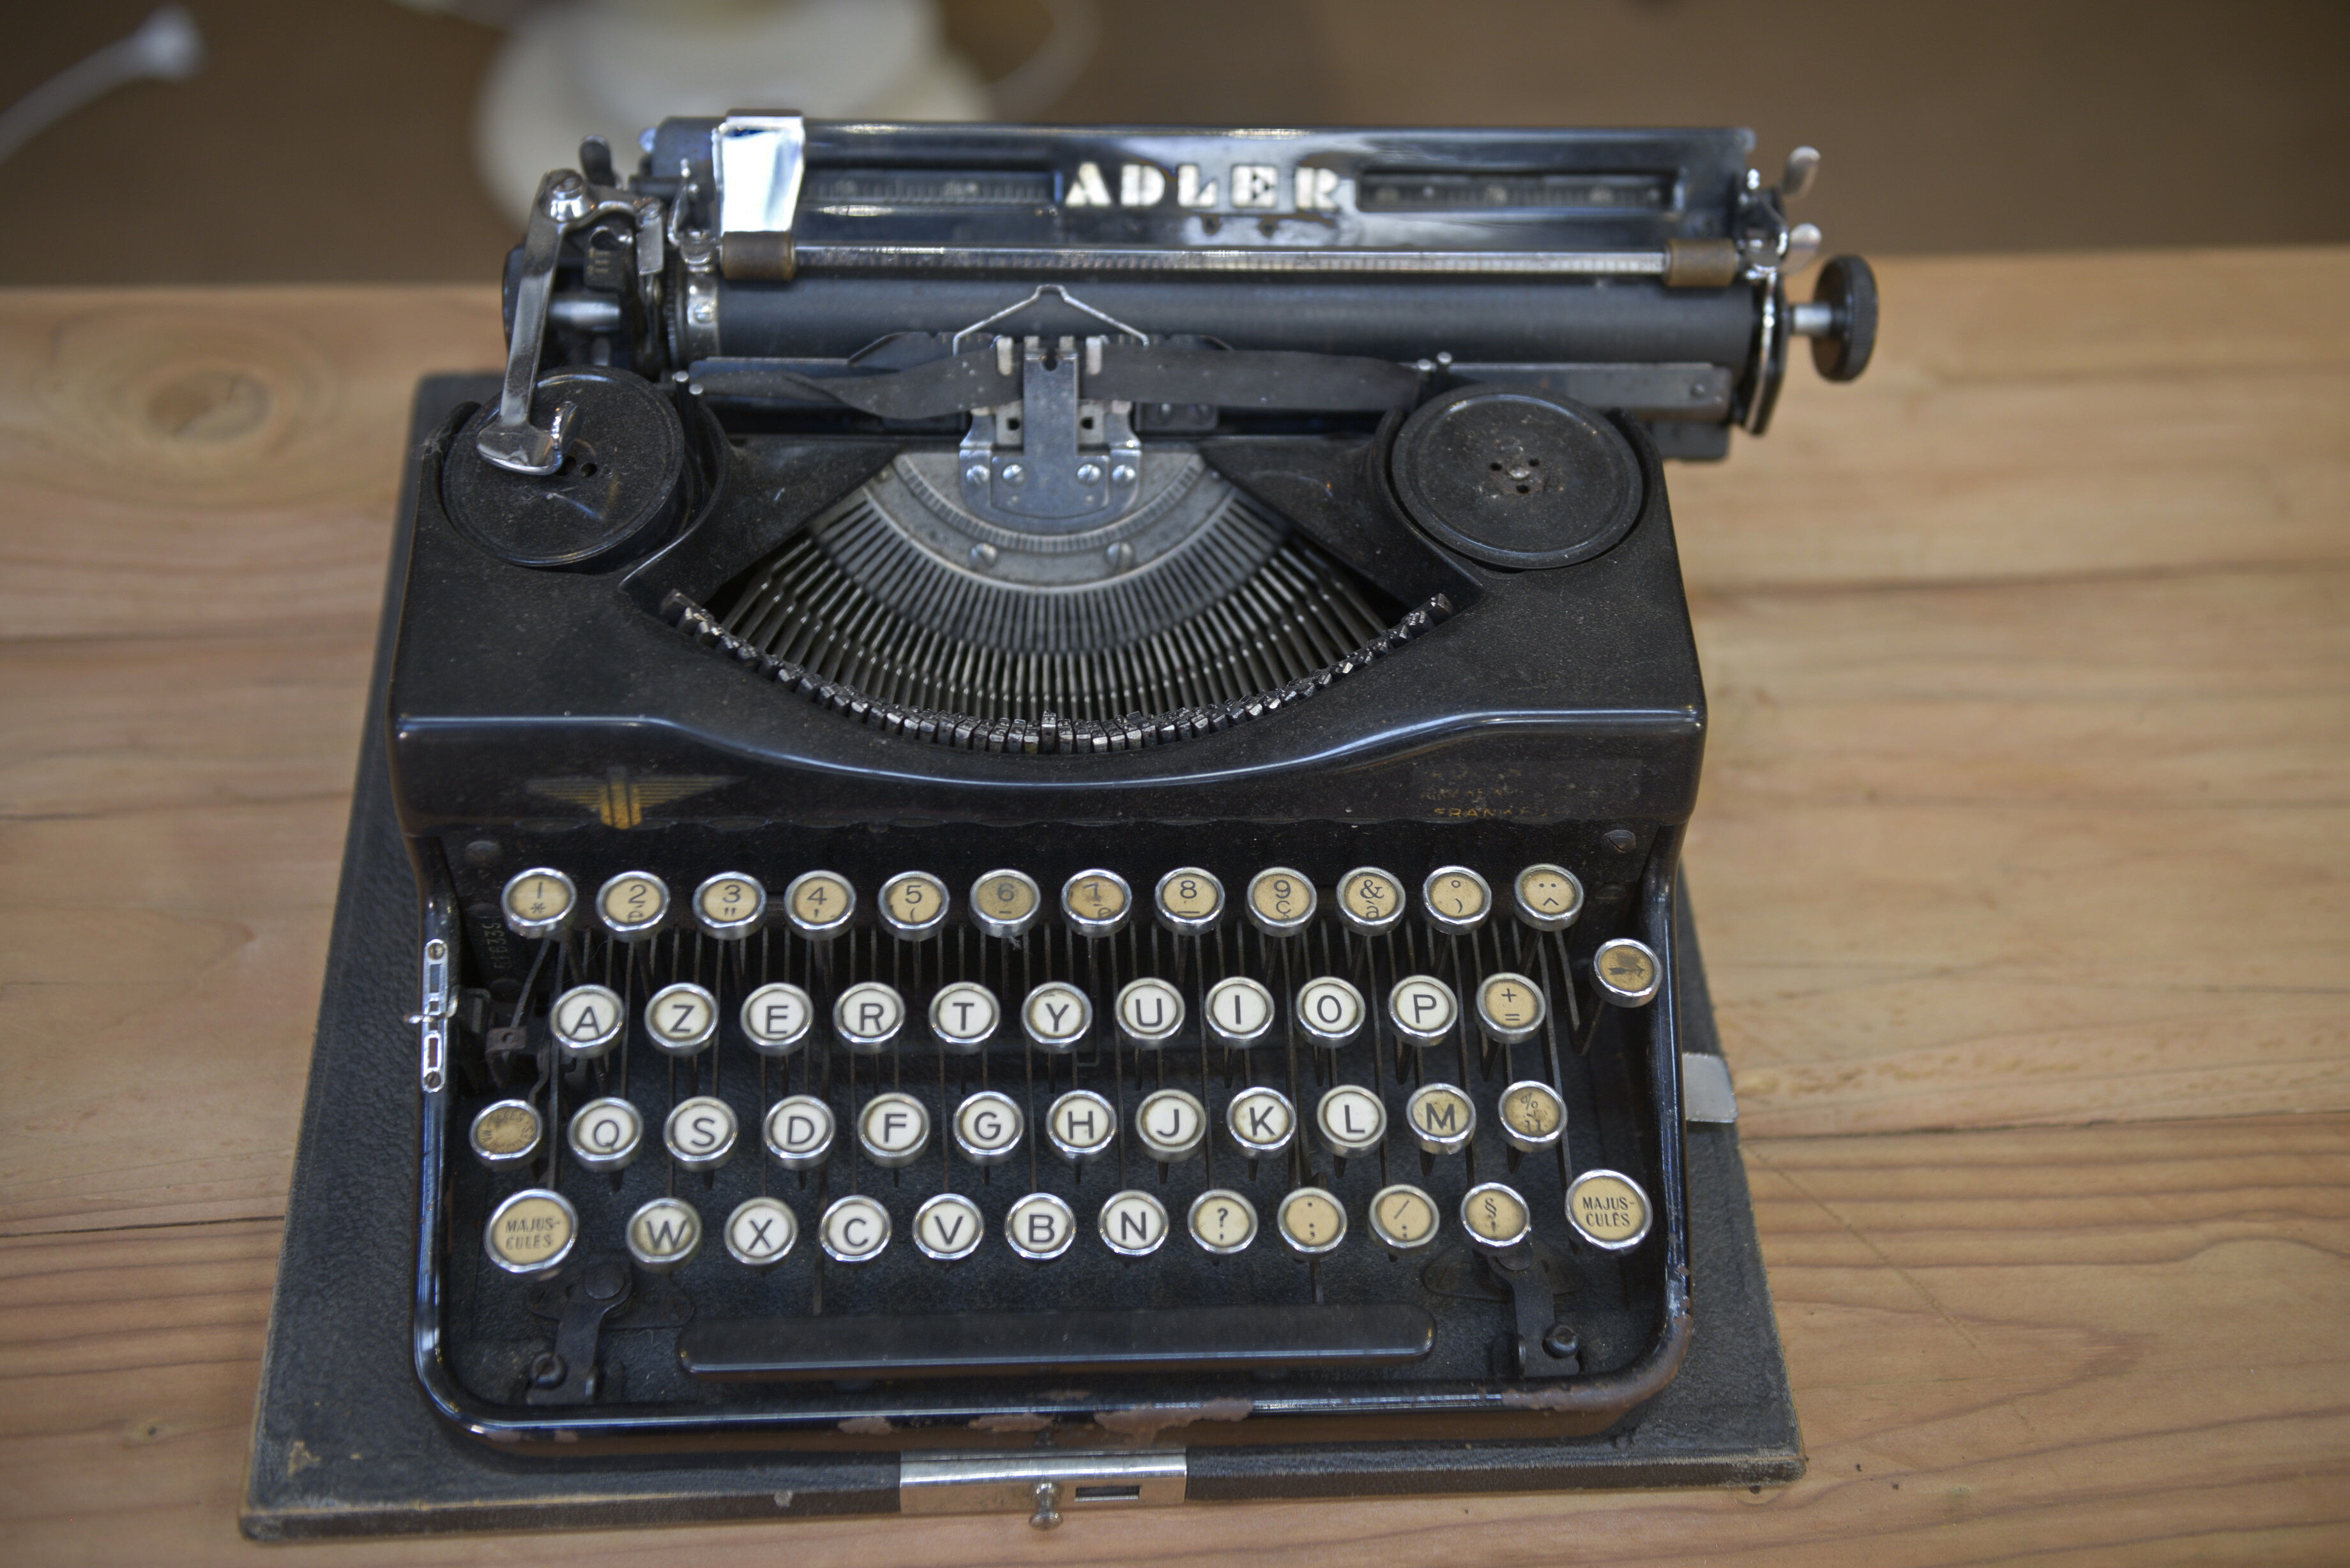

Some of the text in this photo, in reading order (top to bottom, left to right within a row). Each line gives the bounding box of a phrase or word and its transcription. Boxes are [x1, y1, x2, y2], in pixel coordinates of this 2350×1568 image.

[1066, 162, 1338, 211] ADLER
[628, 884, 647, 904] 2
[722, 884, 740, 903] 3
[807, 887, 827, 905] 4
[905, 885, 921, 903] 5
[997, 883, 1014, 902] 6
[1083, 882, 1100, 901] 7
[1180, 880, 1197, 899] 8
[1273, 880, 1291, 898] 9
[1360, 879, 1384, 899] &
[1455, 898, 1463, 913] )
[1317, 995, 1342, 1023] O
[1413, 993, 1437, 1023] P
[1501, 988, 1517, 1002] +
[570, 1006, 600, 1035] A
[670, 1005, 694, 1032] Z
[766, 1006, 789, 1035] E
[860, 1003, 884, 1032] R
[952, 1002, 974, 1030] T
[1046, 1002, 1070, 1032] Y
[1135, 998, 1162, 1027] U
[1234, 995, 1241, 1024] I
[1520, 1092, 1538, 1110] %
[787, 1116, 814, 1145] D
[883, 1113, 907, 1143] F
[974, 1112, 1001, 1140] G
[1068, 1111, 1094, 1139] H
[1156, 1109, 1179, 1138] J
[1249, 1106, 1276, 1136] K
[1344, 1104, 1365, 1133] L
[1426, 1103, 1455, 1131] M
[593, 1120, 619, 1150] Q
[692, 1117, 716, 1149] S
[1217, 1208, 1229, 1226] ?
[1394, 1200, 1409, 1220] /
[1582, 1196, 1635, 1212] MAJUS-
[505, 1217, 561, 1233] MAJUS-
[844, 1218, 868, 1246] C
[934, 1216, 964, 1245] V
[1029, 1214, 1056, 1243] B
[1121, 1211, 1147, 1240] N
[1586, 1212, 1631, 1227] CULES
[505, 1234, 552, 1250] CULES
[646, 1219, 687, 1249] W
[747, 1218, 773, 1251] X
